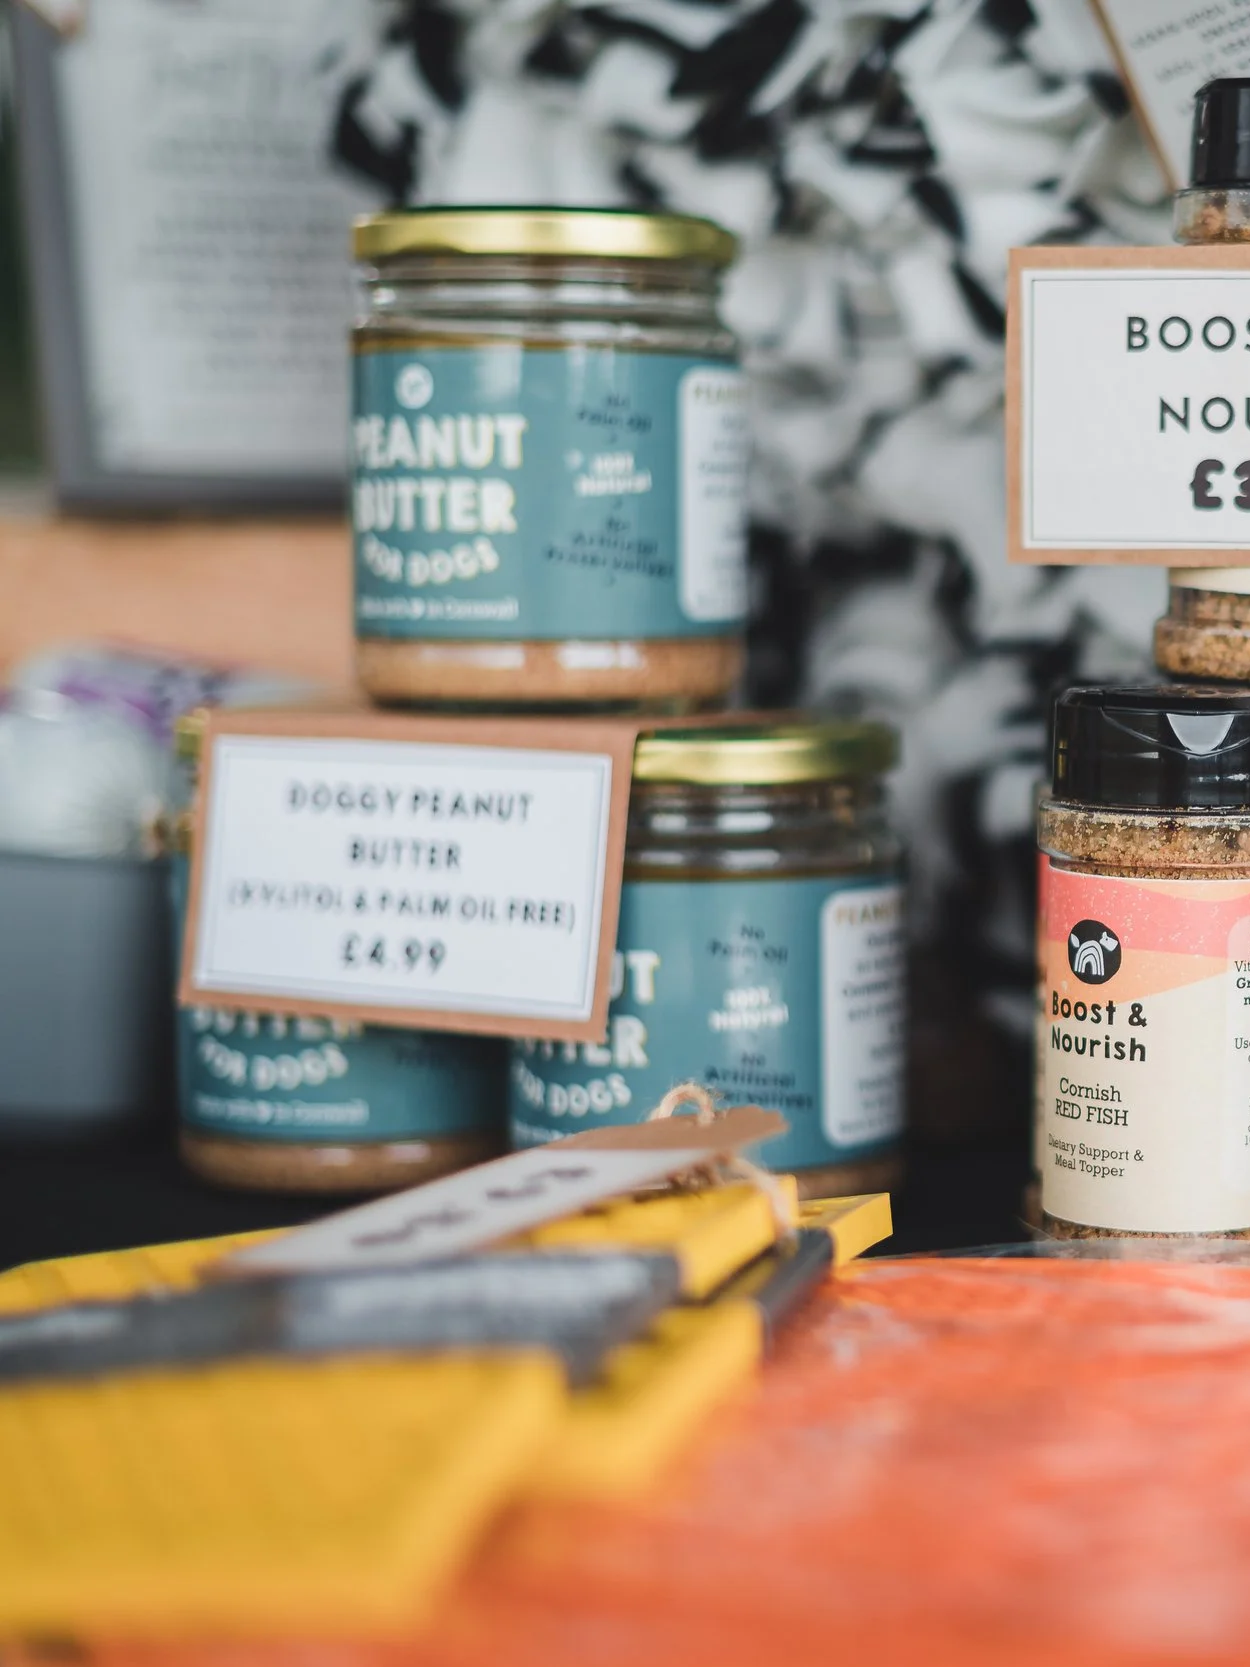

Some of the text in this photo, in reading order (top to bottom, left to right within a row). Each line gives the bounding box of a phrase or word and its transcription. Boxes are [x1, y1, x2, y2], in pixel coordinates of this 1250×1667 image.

[405, 536, 500, 588] DOGS
[288, 781, 533, 821] DOGGY PEANUT
[348, 839, 460, 868] BUTTER
[379, 891, 450, 919] PALM
[459, 896, 496, 921] OIL
[508, 901, 576, 934] FREE)
[1052, 990, 1148, 1028] Boost &
[1051, 1027, 1147, 1063] Nourish
[250, 1042, 348, 1092] DOGS
[547, 1073, 632, 1117] DOGS
[1059, 1077, 1122, 1103] Cornish
[1055, 1098, 1129, 1127] RED FISH
[1055, 1152, 1125, 1179] Meal Topper
[1078, 1143, 1131, 1163] Support
[1134, 1149, 1145, 1162] &
